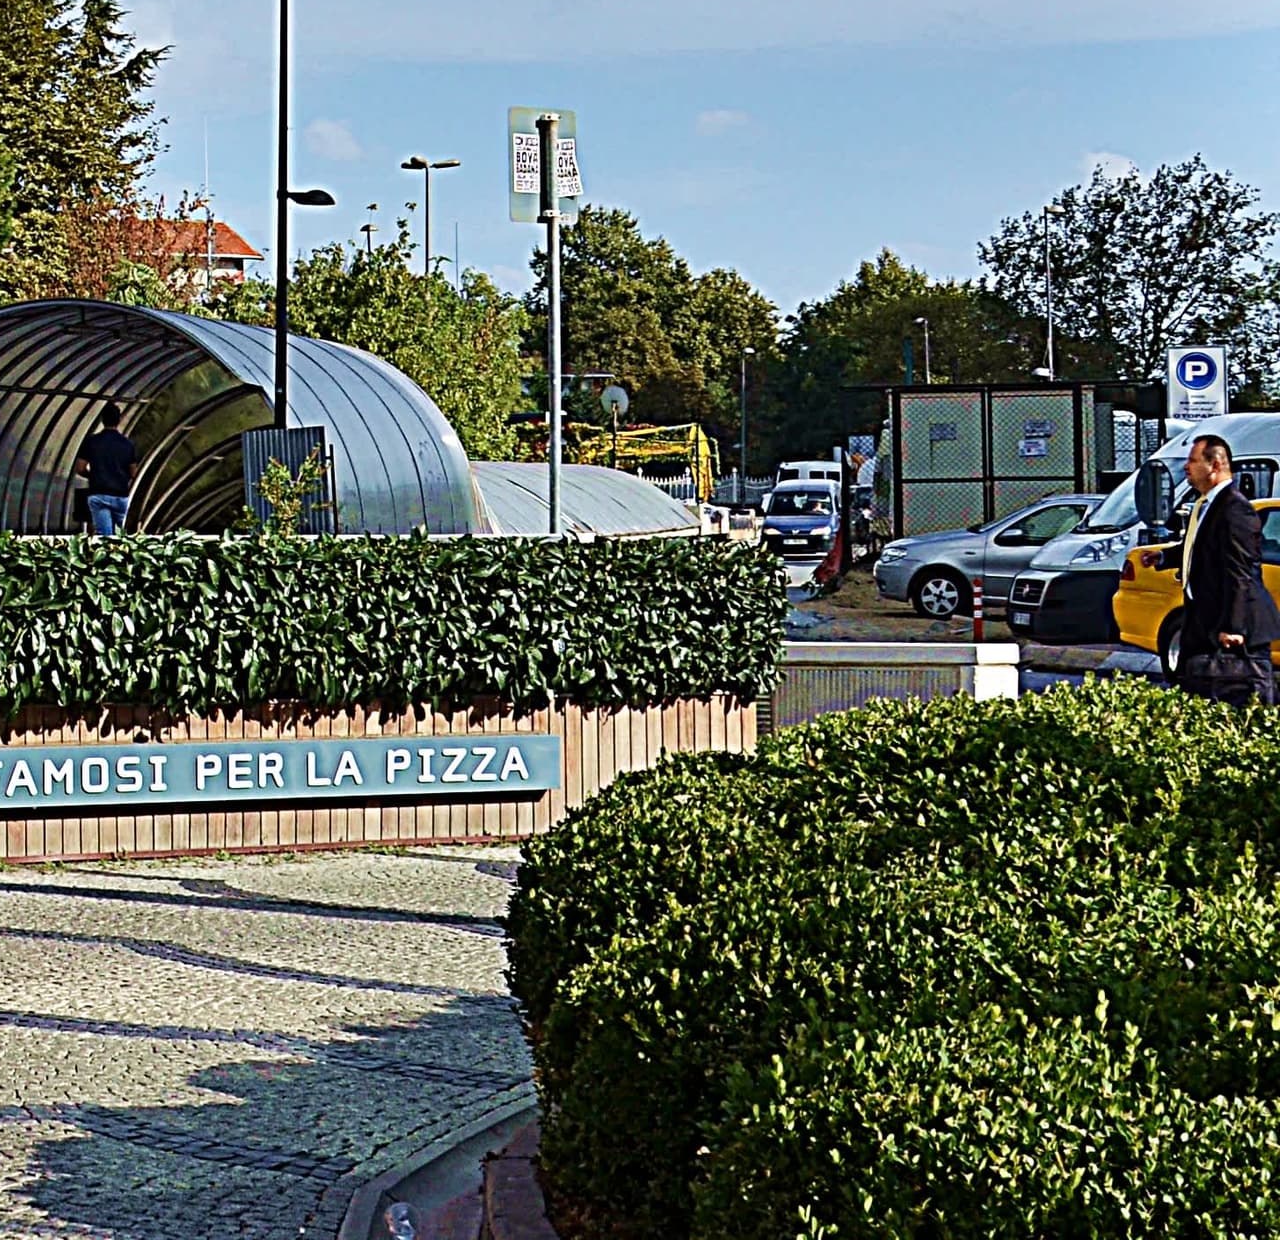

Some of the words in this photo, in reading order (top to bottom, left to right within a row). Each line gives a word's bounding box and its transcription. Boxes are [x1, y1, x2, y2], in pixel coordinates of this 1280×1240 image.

[516, 151, 538, 164] BOYA
[558, 156, 576, 168] OYA
[1185, 361, 1209, 382] P
[196, 751, 286, 790] PER
[306, 749, 364, 787] LA
[386, 745, 530, 784] PIZZA
